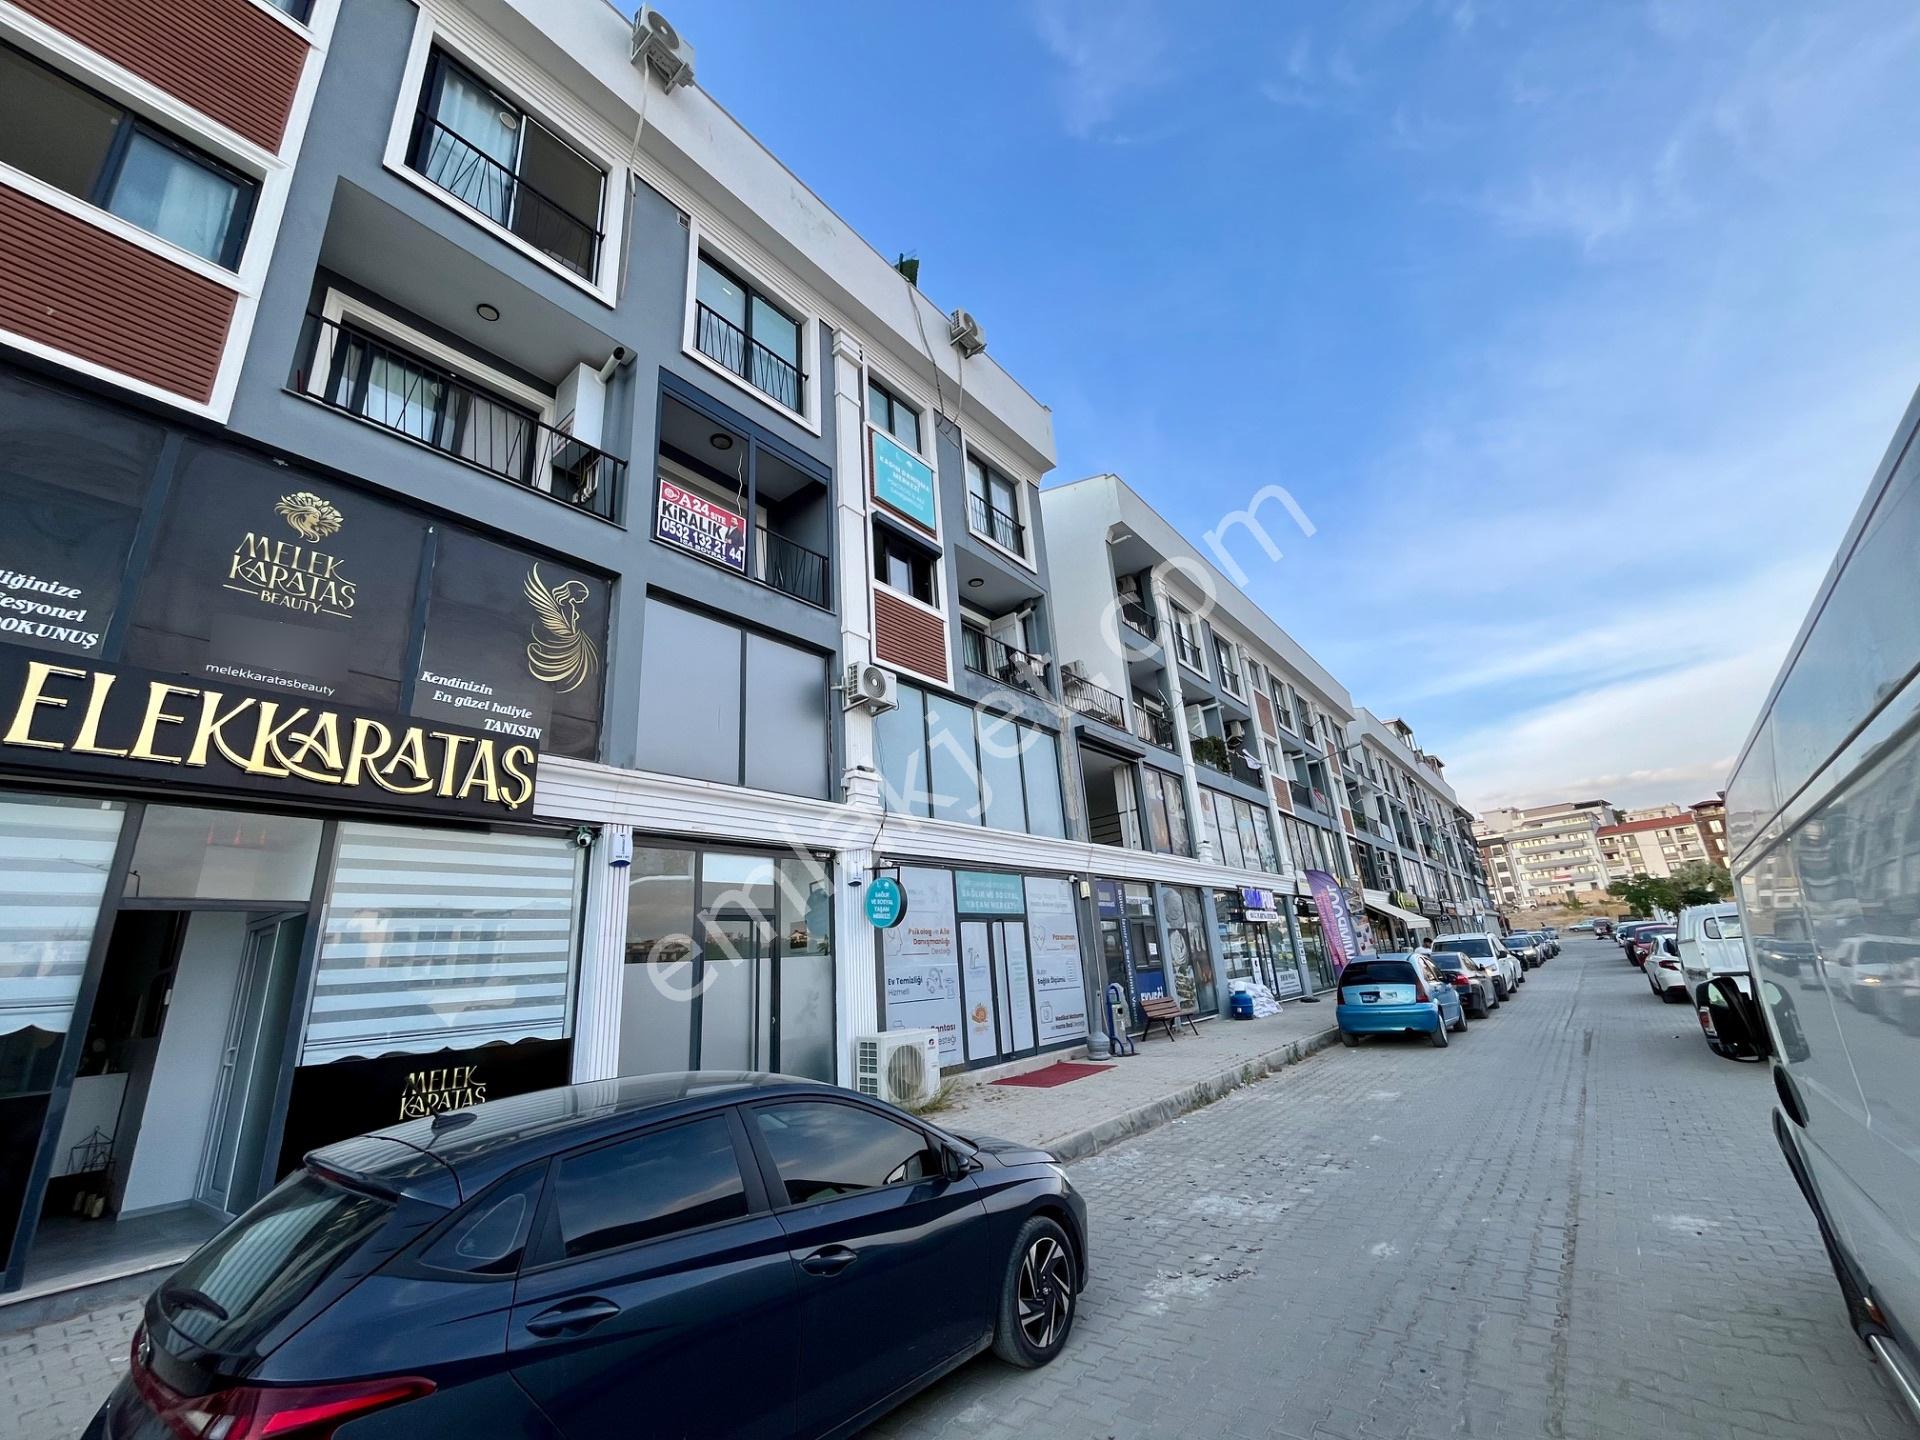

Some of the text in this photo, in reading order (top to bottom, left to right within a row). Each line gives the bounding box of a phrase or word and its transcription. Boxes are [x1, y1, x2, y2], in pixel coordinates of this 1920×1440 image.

[661, 517, 742, 562] 0532 132 21 44
[694, 544, 727, 562] BOYRAZ
[235, 532, 357, 586] MELEK
[260, 590, 323, 614] BEAUTY
[0, 616, 99, 649] OKUNUŞ
[206, 663, 335, 697] melekkaratasbeauty
[421, 671, 493, 696] Kendinizin
[432, 690, 533, 719] En güzel haliyle
[908, 928, 932, 936] Psikolog
[888, 976, 923, 986] Ev Temizliği
[938, 1034, 957, 1046] esteği
[401, 1065, 487, 1096] MELEK
